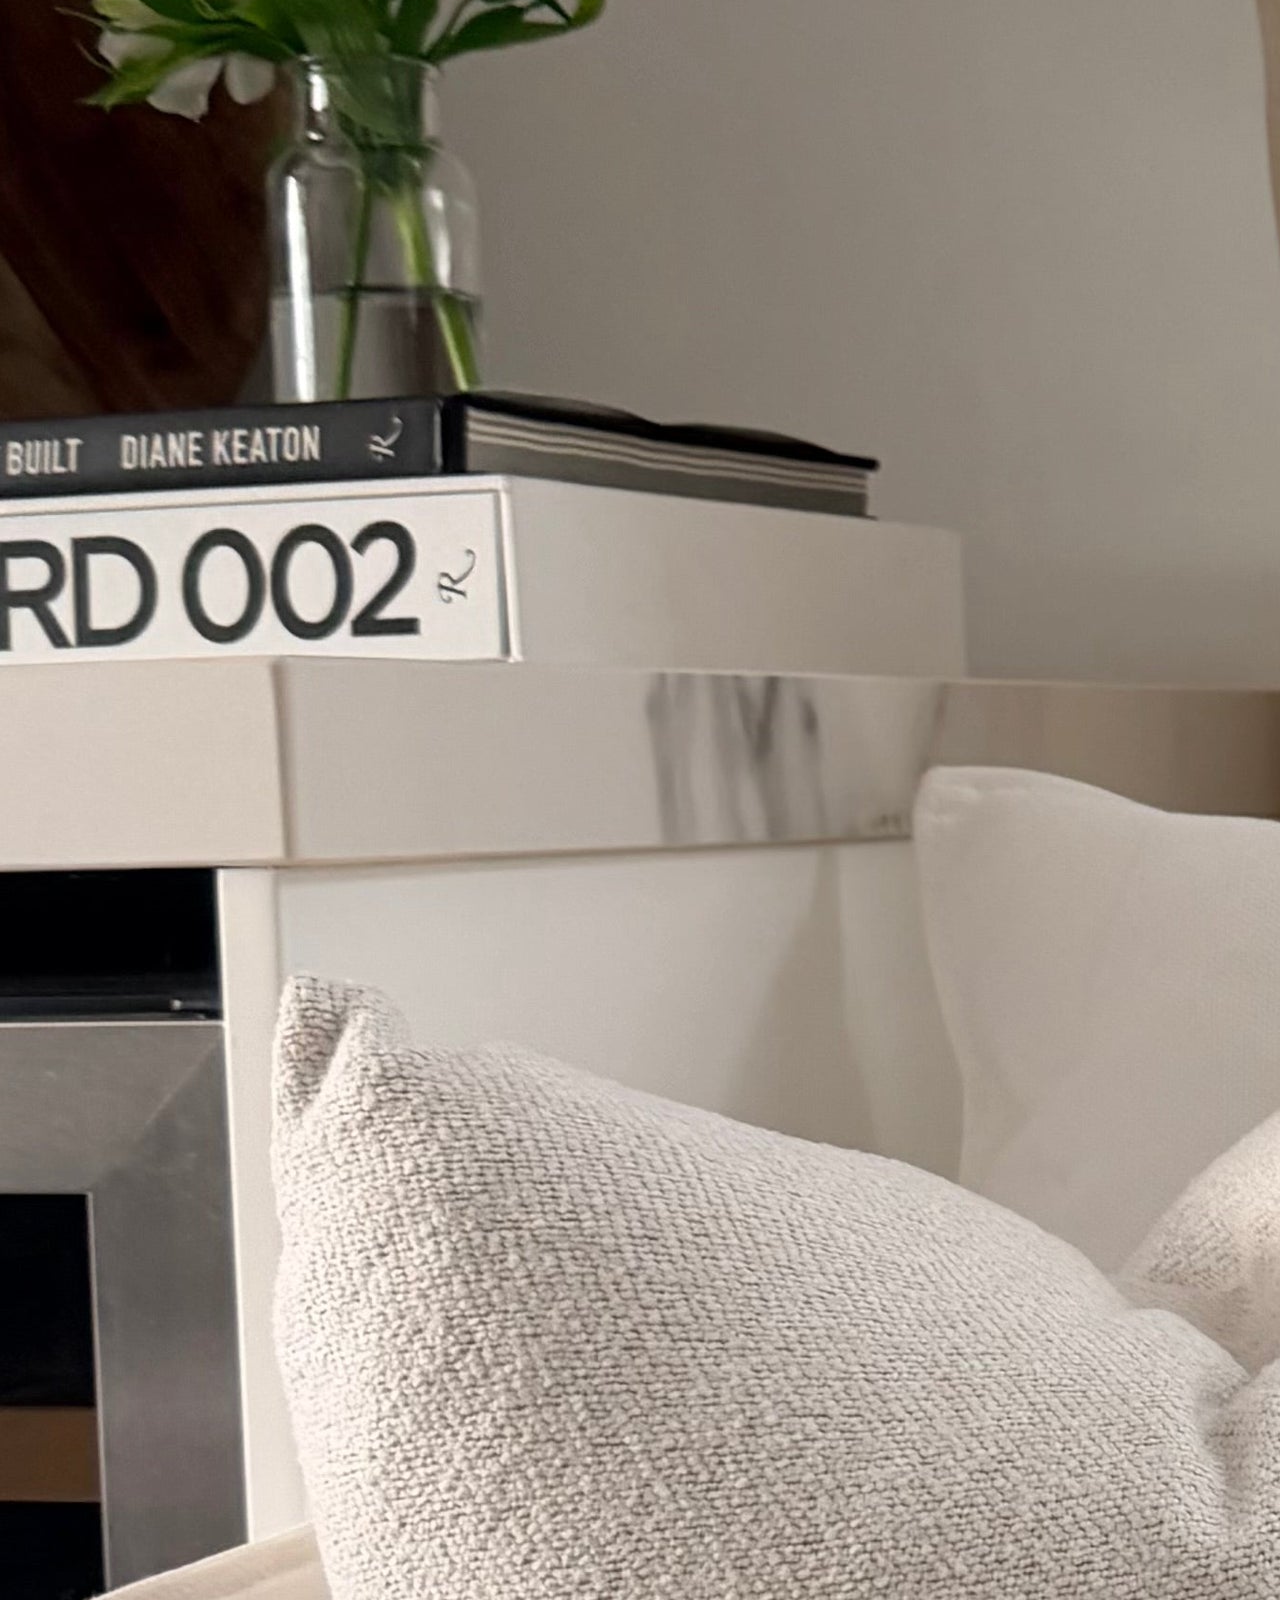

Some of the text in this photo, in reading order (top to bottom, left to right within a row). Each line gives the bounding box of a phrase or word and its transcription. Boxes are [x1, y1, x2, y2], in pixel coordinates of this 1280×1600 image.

[6, 425, 322, 476] BUILT DIANE KEATON
[182, 519, 421, 644] 002
